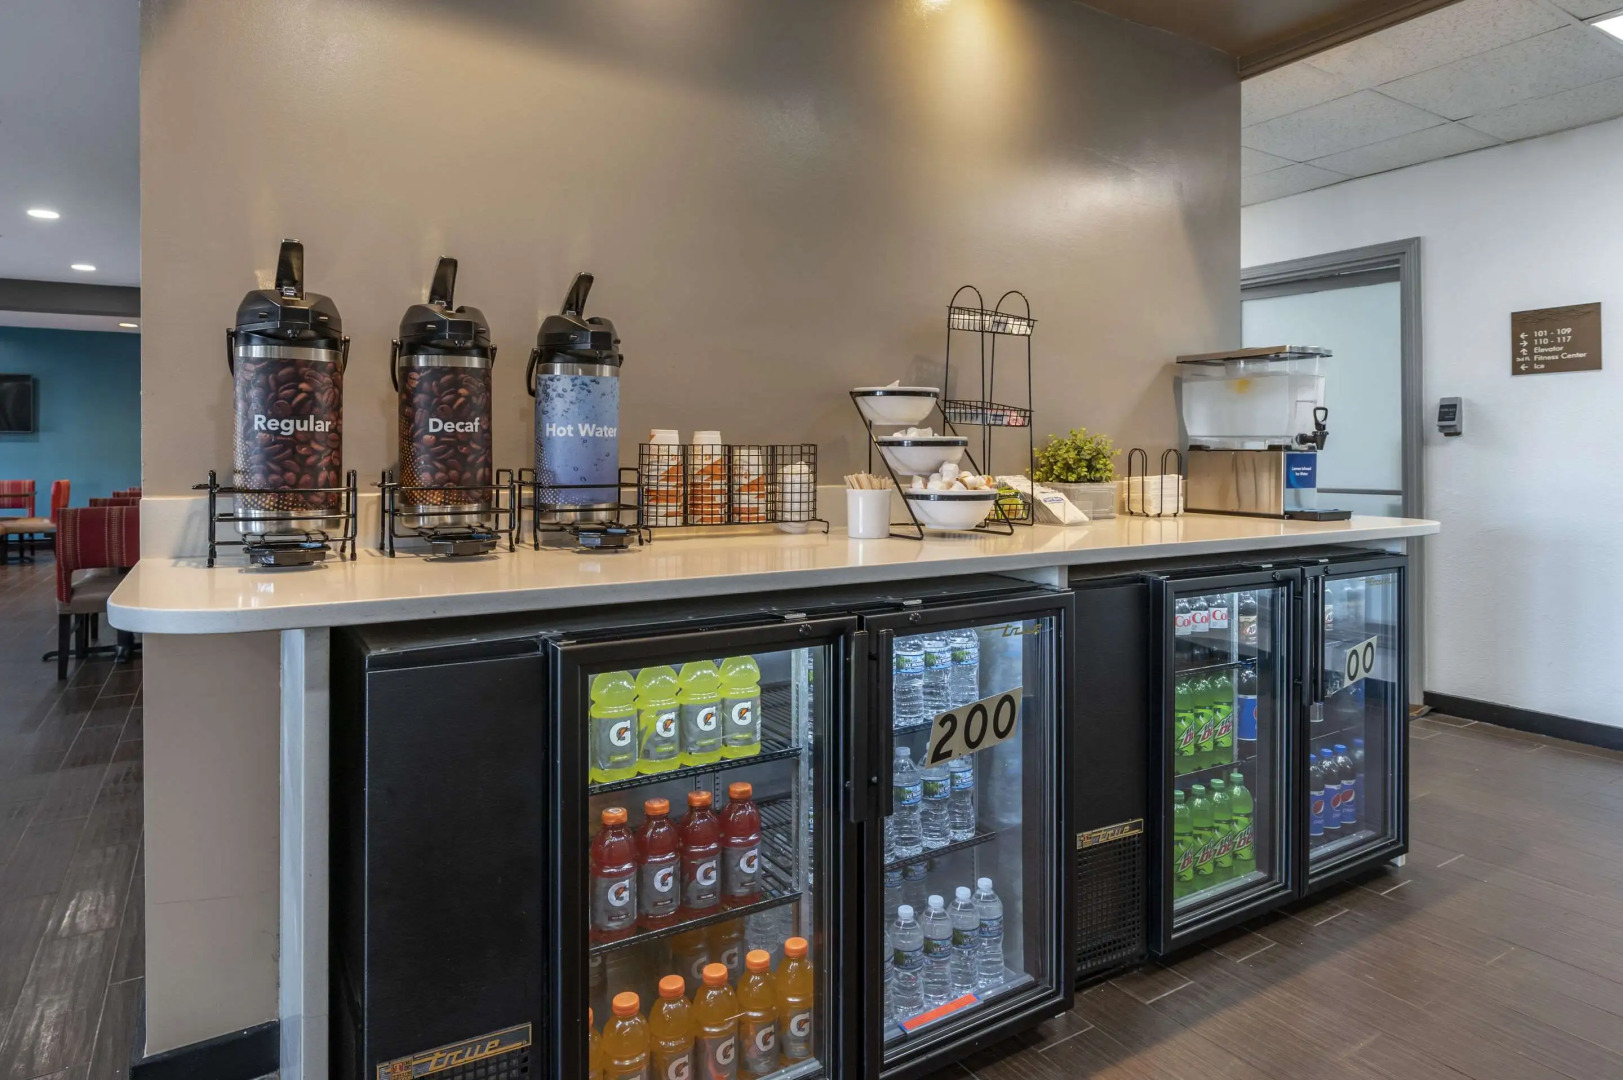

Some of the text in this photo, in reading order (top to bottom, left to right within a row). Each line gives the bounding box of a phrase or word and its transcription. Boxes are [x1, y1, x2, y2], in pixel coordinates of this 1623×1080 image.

[254, 414, 332, 436] Regular
[428, 417, 480, 433] Decaf
[545, 423, 617, 437] Hot Water
[1347, 642, 1375, 682] 00
[656, 711, 676, 738] G
[697, 706, 716, 732] G
[732, 701, 752, 726] G
[609, 719, 631, 747] G
[696, 860, 716, 886] G
[739, 848, 759, 874] G
[653, 865, 674, 893] G
[608, 879, 630, 907] G
[790, 1012, 809, 1037] G
[716, 1036, 735, 1066] G
[755, 1025, 775, 1052] G
[425, 1039, 504, 1071] true
[668, 1054, 689, 1080] G
